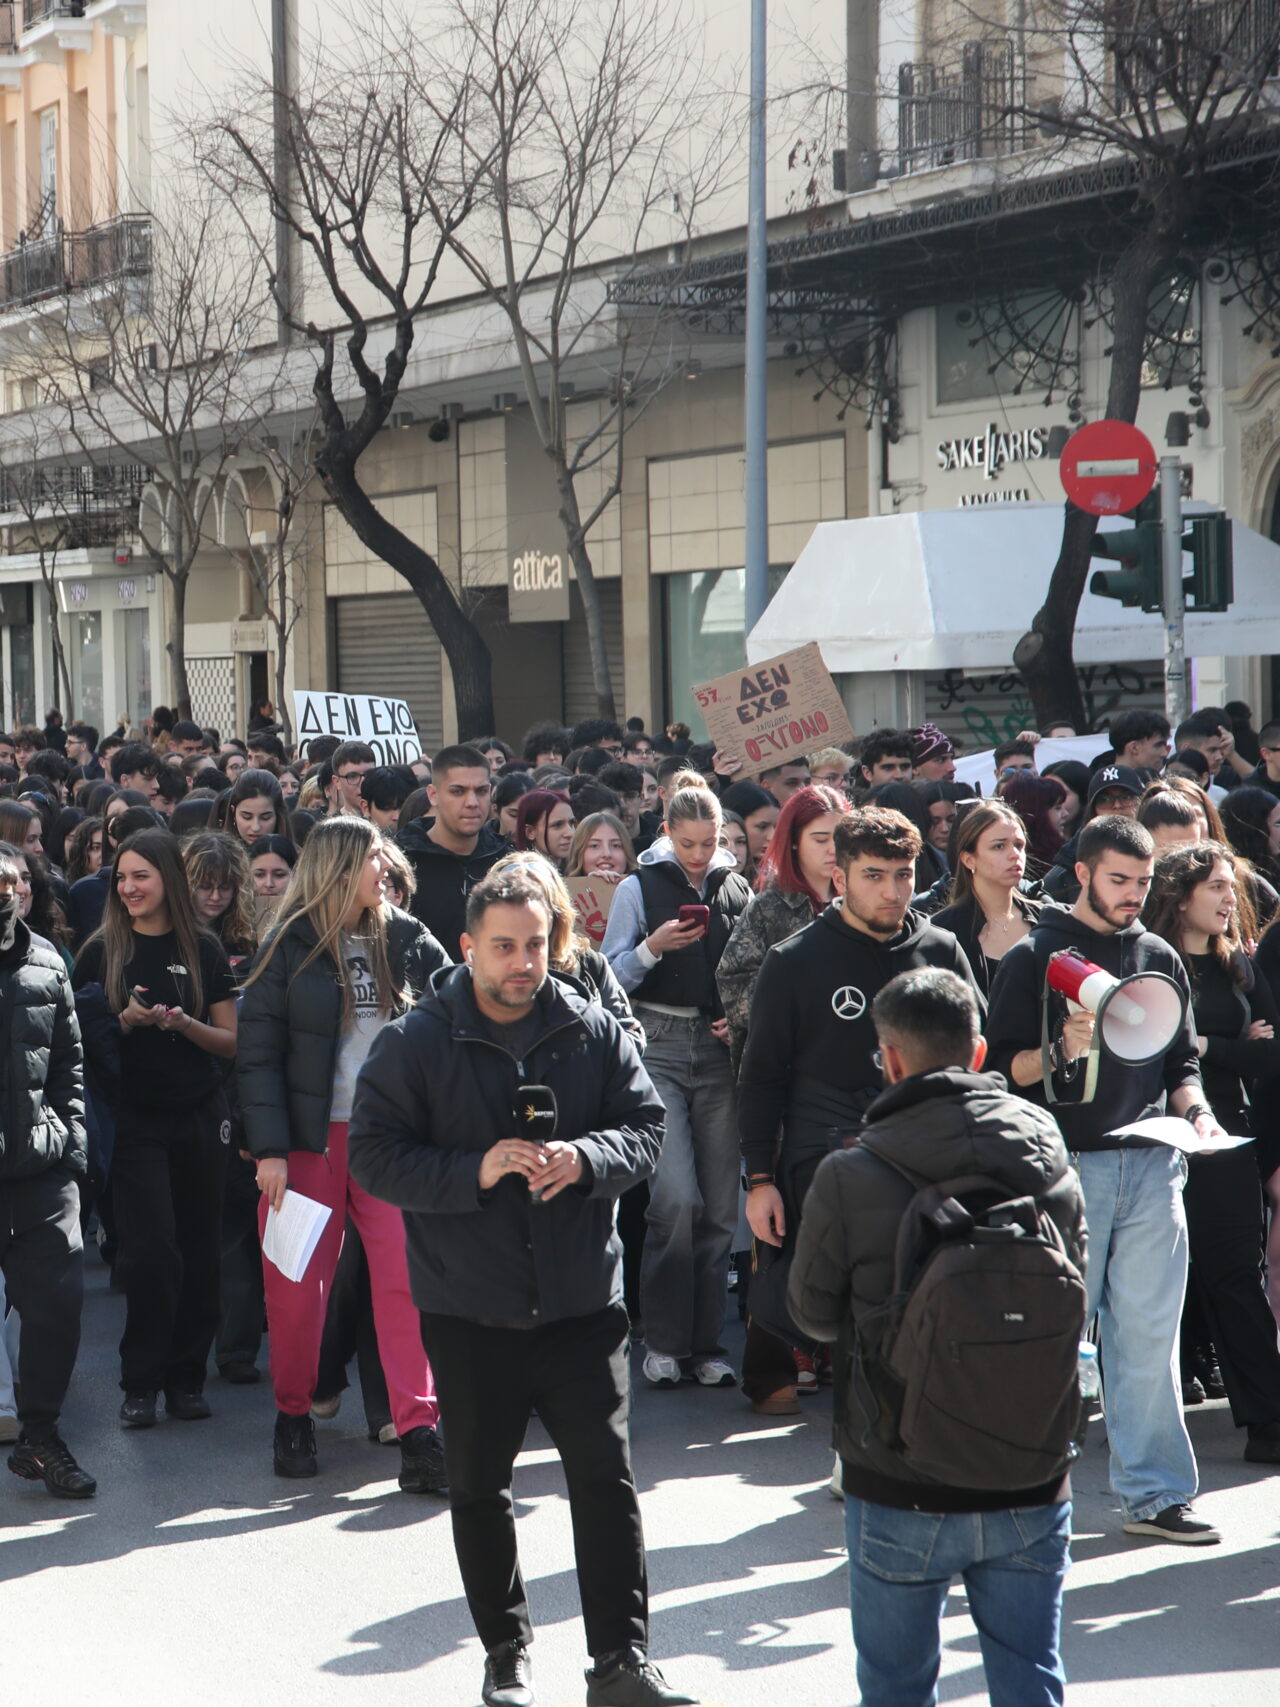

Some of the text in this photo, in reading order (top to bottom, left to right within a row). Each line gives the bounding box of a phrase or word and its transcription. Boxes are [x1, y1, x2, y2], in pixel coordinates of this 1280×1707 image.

[936, 423, 1045, 480] SAKELLARIS
[513, 550, 563, 591] attica
[697, 689, 718, 707] 57
[740, 663, 791, 702] ΔΕΝ
[300, 695, 417, 736] ΔΕΝ ΕΧΩ
[736, 689, 790, 725] ΕΧΩ
